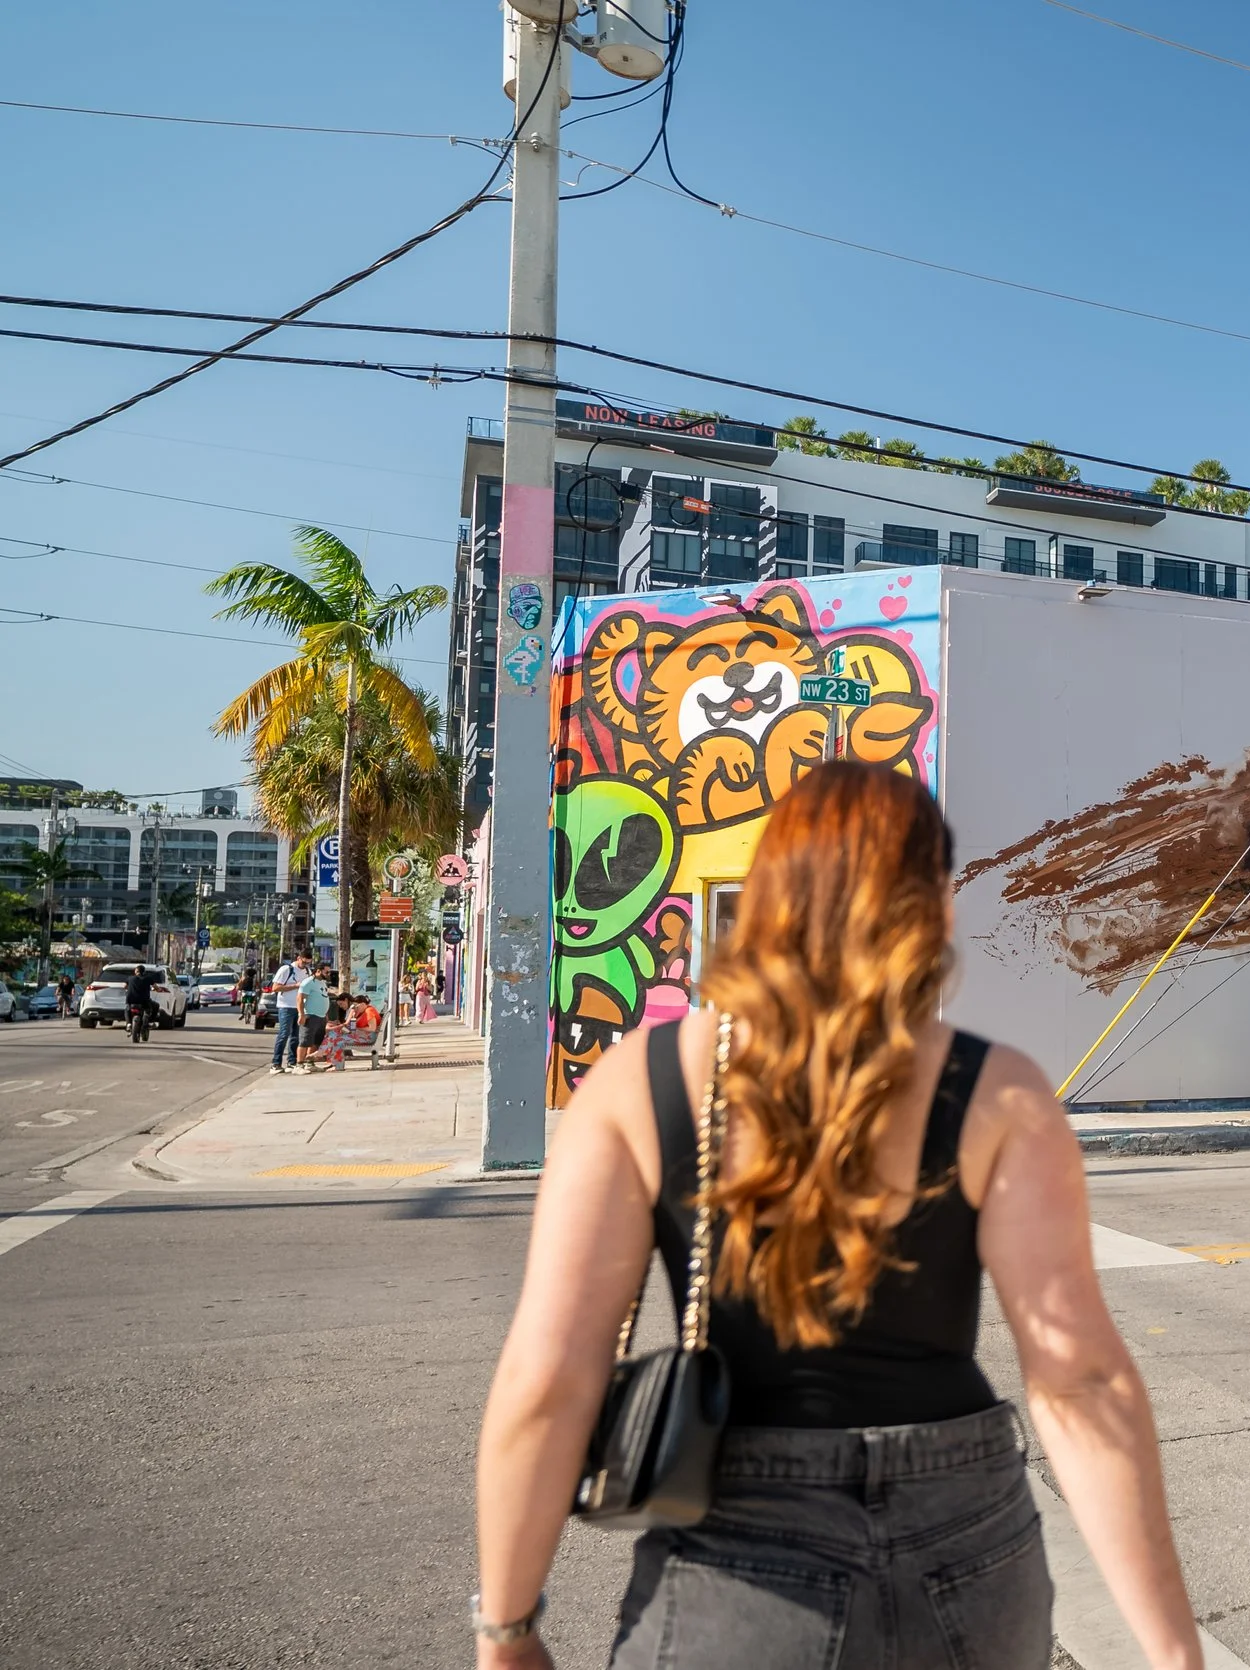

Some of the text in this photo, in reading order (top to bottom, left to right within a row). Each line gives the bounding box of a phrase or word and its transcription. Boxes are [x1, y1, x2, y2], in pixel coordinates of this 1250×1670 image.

[585, 405, 628, 424] NOW
[802, 680, 868, 702] NW 23 ST
